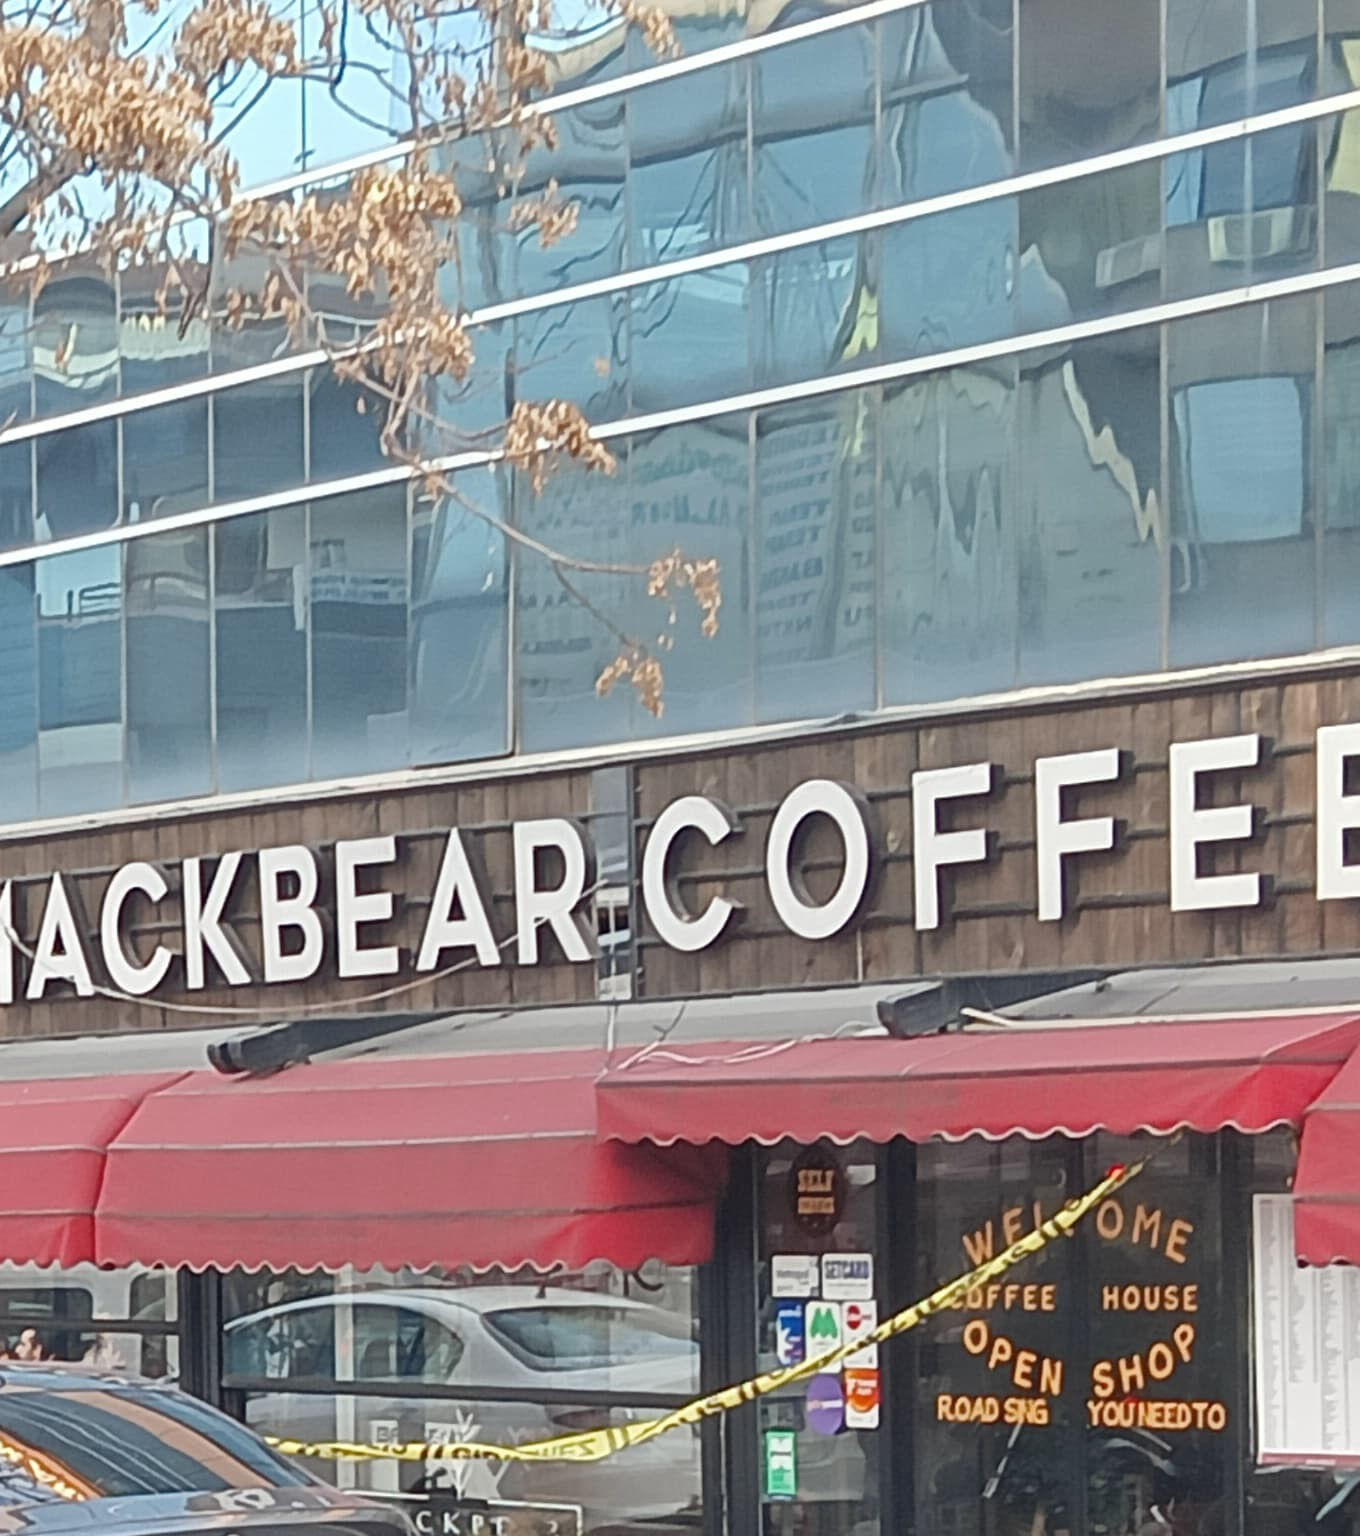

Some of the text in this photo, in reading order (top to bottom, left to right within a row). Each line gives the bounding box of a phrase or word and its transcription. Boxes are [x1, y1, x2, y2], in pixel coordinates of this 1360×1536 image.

[962, 1199, 1194, 1267] WEOME
[1102, 1284, 1199, 1312] HOUSE
[963, 1319, 1196, 1398] OPEN SHOP
